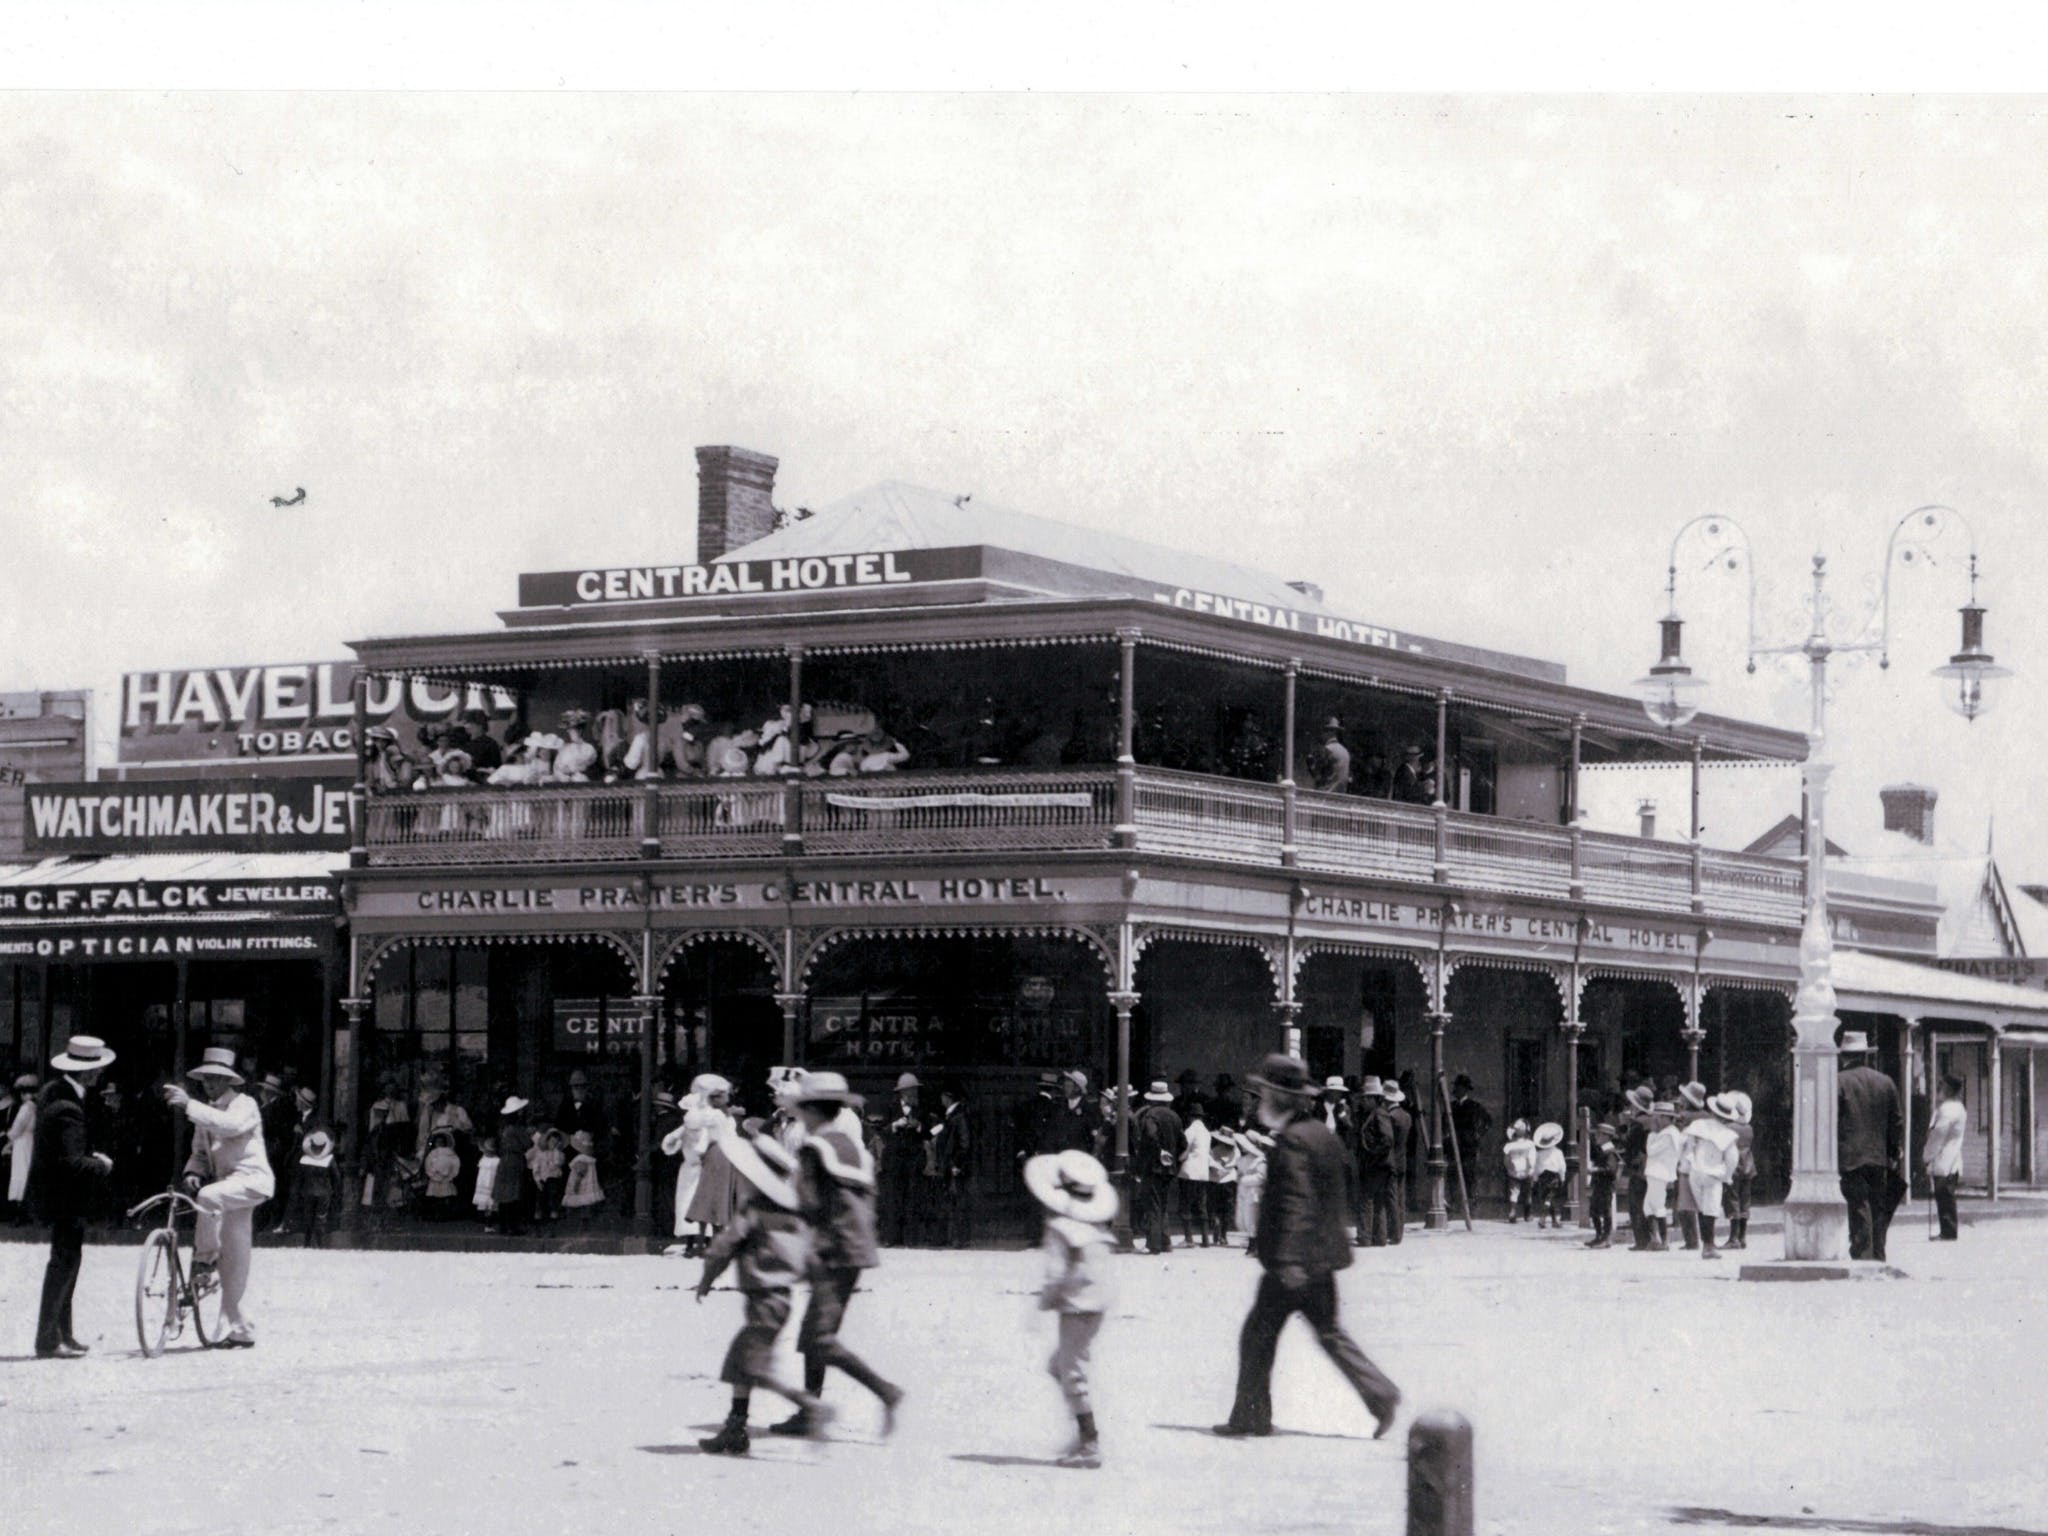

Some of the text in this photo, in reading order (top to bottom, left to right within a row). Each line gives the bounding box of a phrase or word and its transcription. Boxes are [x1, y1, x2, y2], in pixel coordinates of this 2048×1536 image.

[576, 552, 911, 601] CENTRAL HOTEL
[238, 727, 375, 752] TOBAC
[31, 793, 275, 839] WATCHMAKER
[296, 784, 356, 835] JE
[418, 888, 553, 910] CHARLIE
[762, 880, 918, 903] CENTRAL
[1306, 897, 1400, 921] CHARLIE
[1528, 918, 1612, 943] CENTAL
[37, 936, 192, 956] OPTICIAN
[196, 938, 242, 950] VIOLIN
